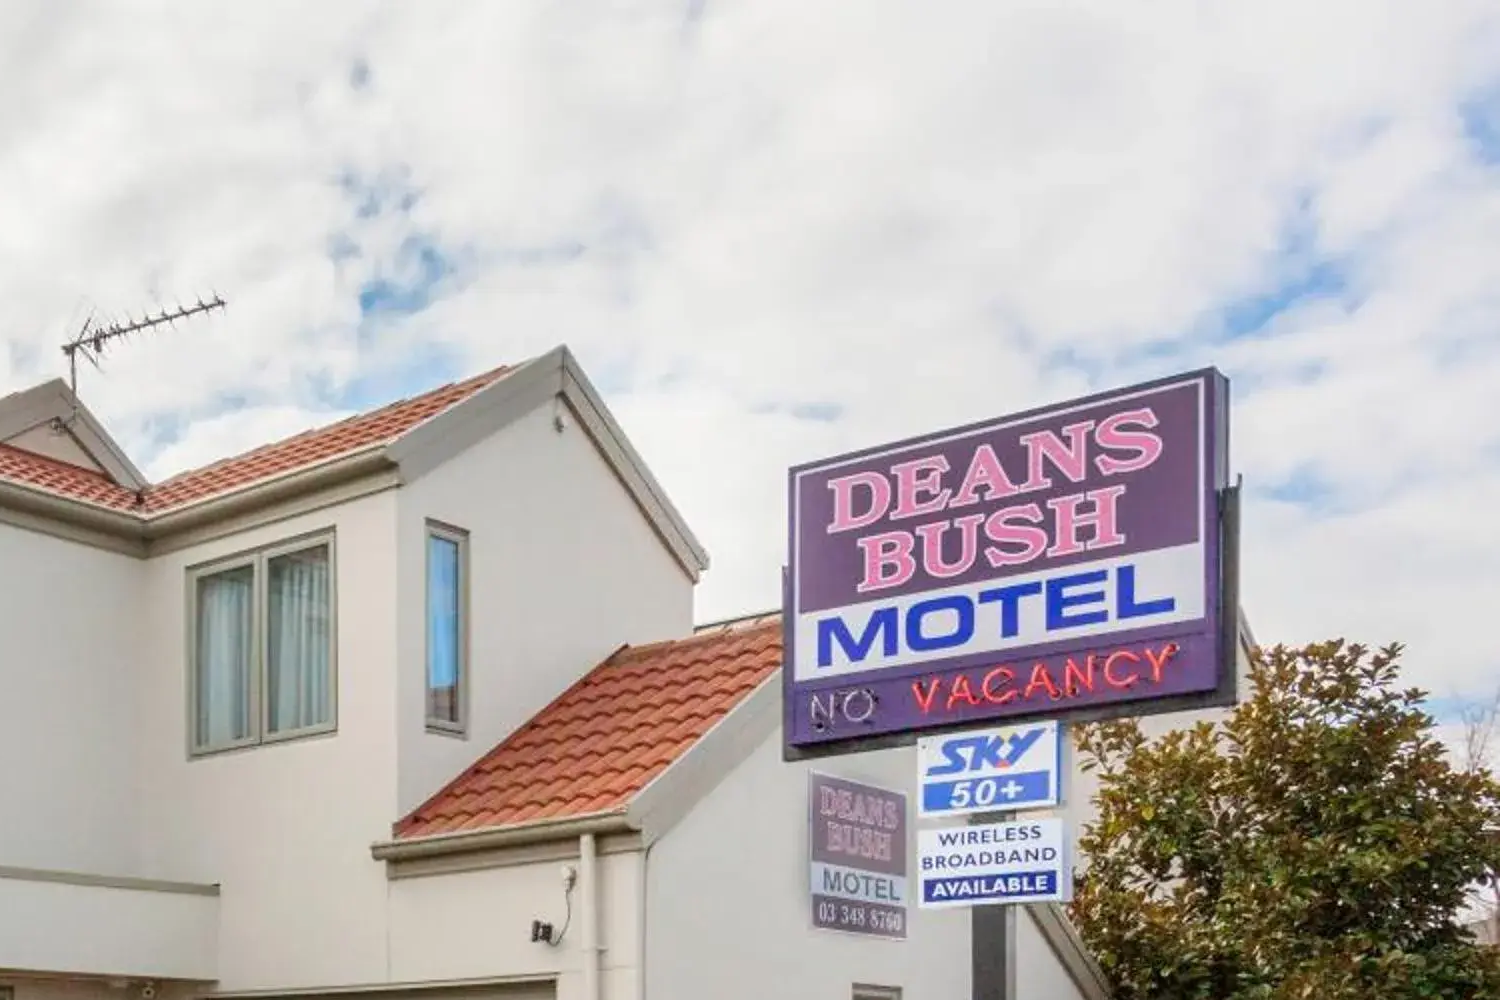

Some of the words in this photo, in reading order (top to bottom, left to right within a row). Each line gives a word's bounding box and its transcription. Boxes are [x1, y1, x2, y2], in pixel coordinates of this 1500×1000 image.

[827, 407, 1163, 534] DEANS
[857, 486, 1126, 593] BUSH
[817, 565, 1175, 668] MOTEL
[811, 688, 875, 725] NO
[911, 643, 1178, 715] VACANCY
[926, 727, 1047, 777] SKY
[820, 785, 898, 829] DEANS
[951, 779, 1024, 807] 50+
[827, 821, 892, 861] BUSH
[938, 825, 1042, 847] WIRELESS
[922, 847, 1057, 870] BROADBAND
[823, 868, 901, 900] MOTEL
[931, 875, 1048, 897] AVAILABLE
